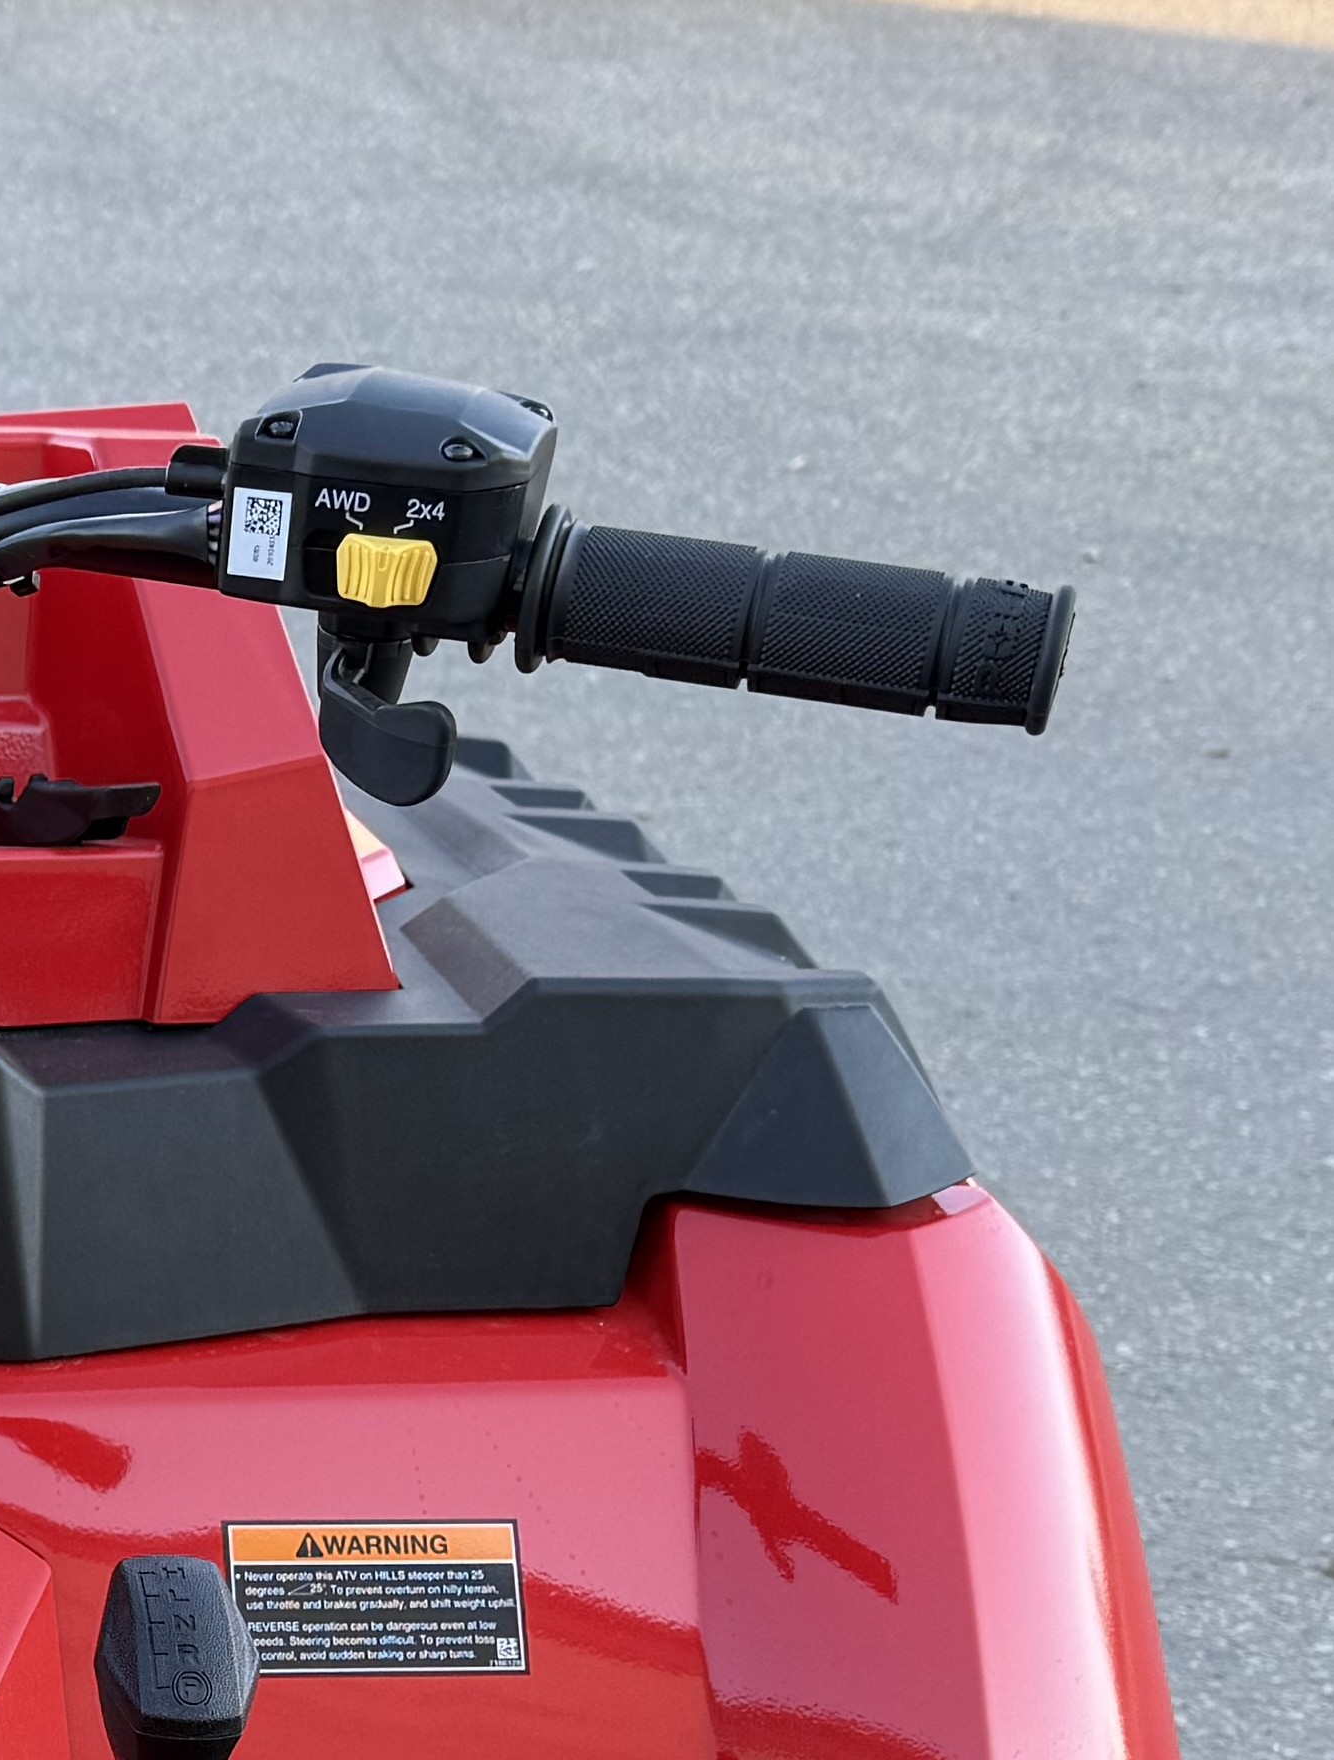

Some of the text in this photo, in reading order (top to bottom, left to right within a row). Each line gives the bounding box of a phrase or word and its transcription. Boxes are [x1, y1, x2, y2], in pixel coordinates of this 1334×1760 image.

[315, 488, 445, 521] AWD 2x4
[323, 1535, 448, 1555] WARNING
[245, 1572, 273, 1581] Never
[276, 1572, 313, 1582] operate
[316, 1571, 333, 1580] this
[336, 1571, 357, 1580] ATV
[375, 1571, 405, 1580] HILLS
[408, 1571, 444, 1581] steeper
[447, 1570, 469, 1579] than
[471, 1570, 484, 1579] 25
[248, 1622, 299, 1632] REVERSE
[302, 1622, 348, 1633] operation
[371, 1621, 383, 1630] be
[386, 1622, 438, 1632] dangerous
[440, 1622, 464, 1630] even
[467, 1621, 477, 1629] at
[479, 1621, 496, 1629] low
